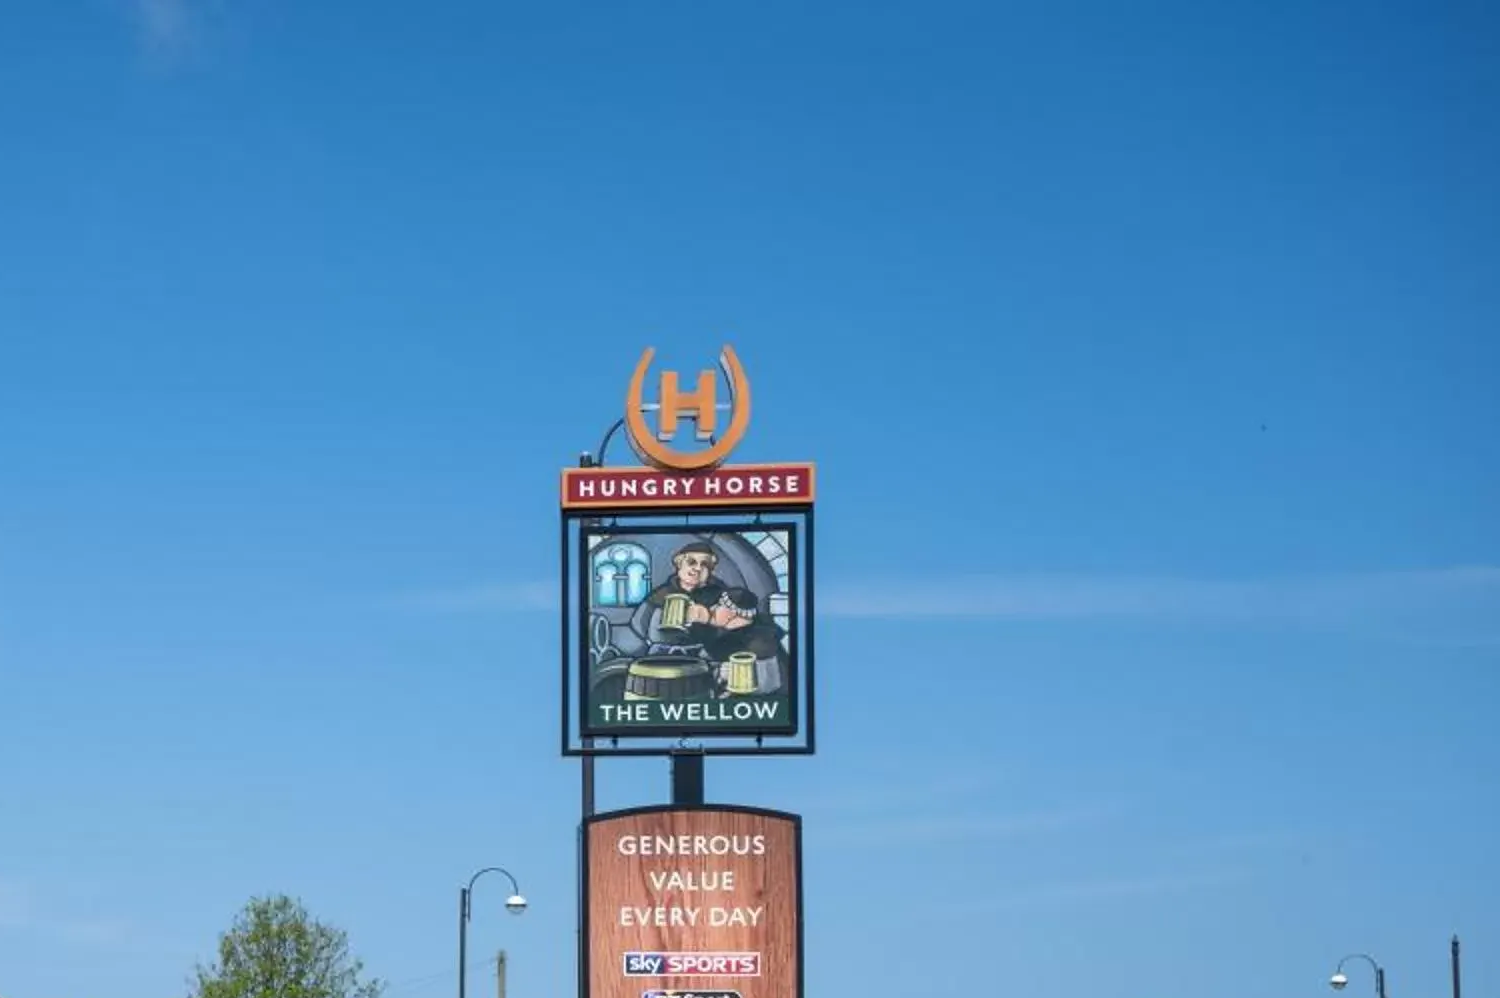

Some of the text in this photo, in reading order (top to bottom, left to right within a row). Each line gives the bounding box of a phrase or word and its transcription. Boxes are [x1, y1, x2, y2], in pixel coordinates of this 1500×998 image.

[579, 474, 800, 498] HUNGRY HORSE
[600, 701, 779, 722] THE WELLOW
[618, 835, 765, 855] GENEROUS
[650, 871, 735, 891] VALUE
[620, 906, 764, 927] EVERY DAY
[629, 953, 755, 975] sky SPORTS
